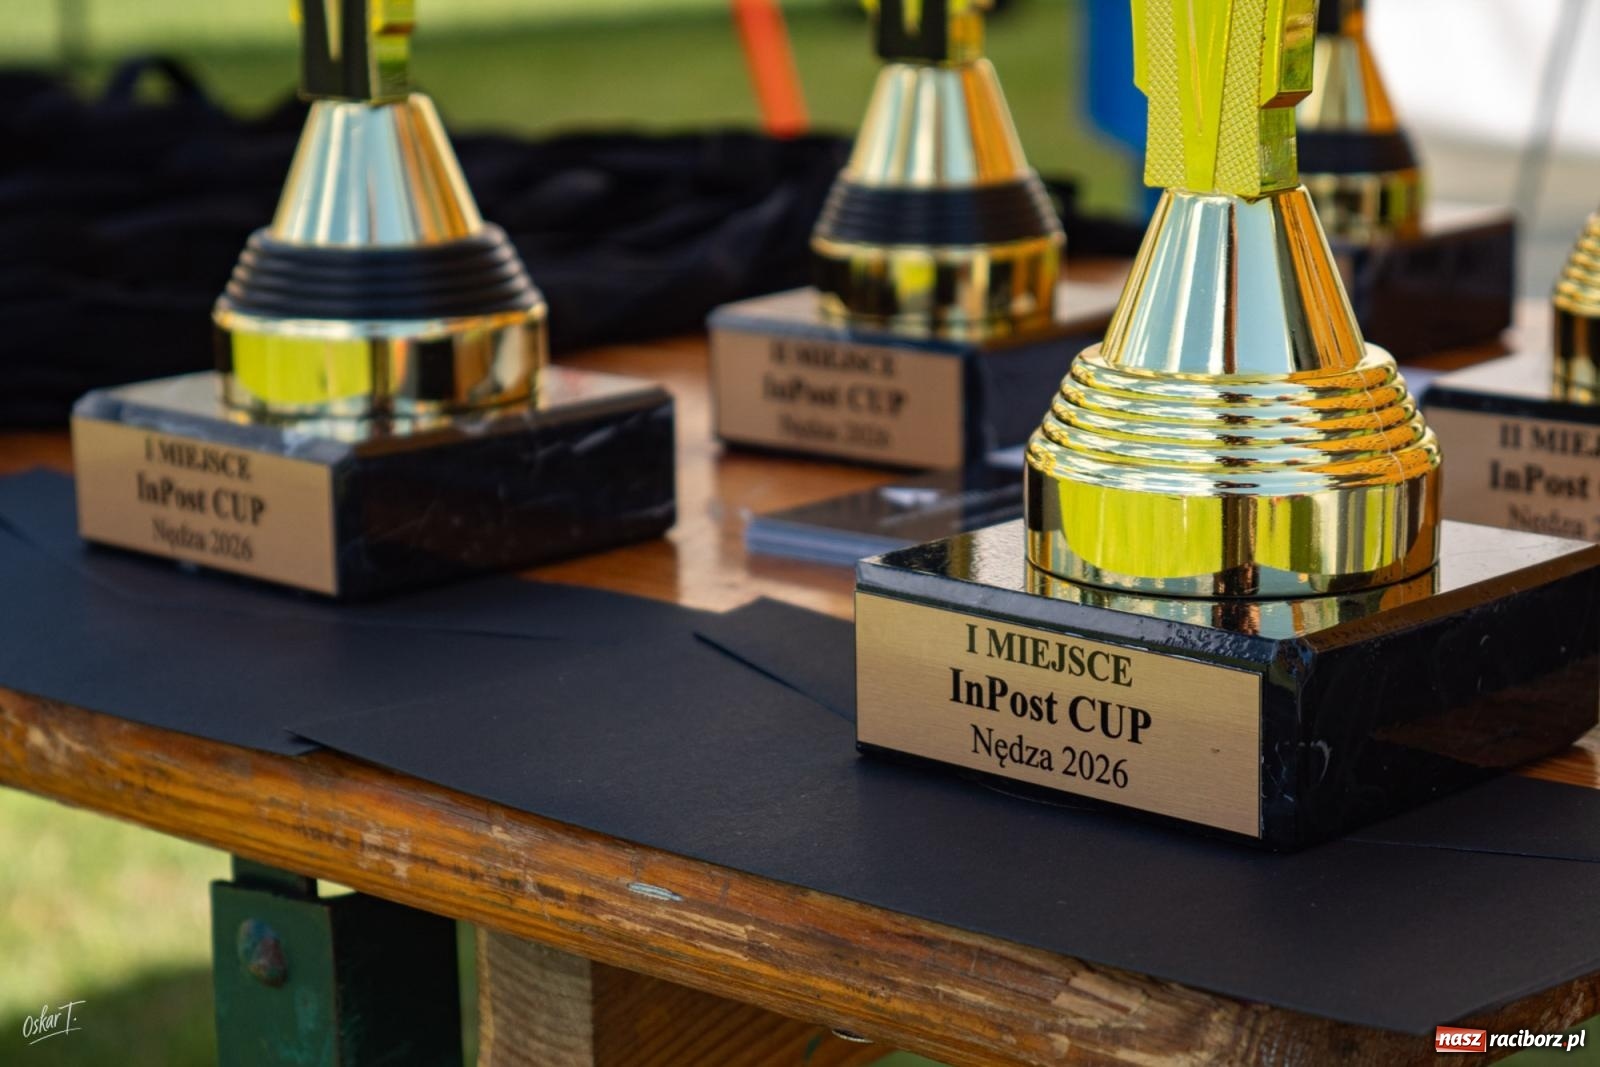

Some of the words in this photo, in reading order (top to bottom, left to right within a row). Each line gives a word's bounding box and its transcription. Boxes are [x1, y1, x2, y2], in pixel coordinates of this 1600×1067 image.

[145, 437, 155, 462] I
[158, 440, 251, 481] MIEJSCE
[1501, 423, 1521, 448] II
[136, 471, 206, 513] InPost
[212, 487, 267, 525] CUP
[1490, 459, 1589, 498] InPost
[210, 529, 254, 562] 2026
[966, 624, 978, 654] I
[987, 627, 1133, 688] MIEJSCE
[949, 667, 1058, 725] InPost
[1069, 695, 1152, 744] CUP
[971, 724, 1053, 771] Nędza
[1061, 746, 1129, 789] 2026
